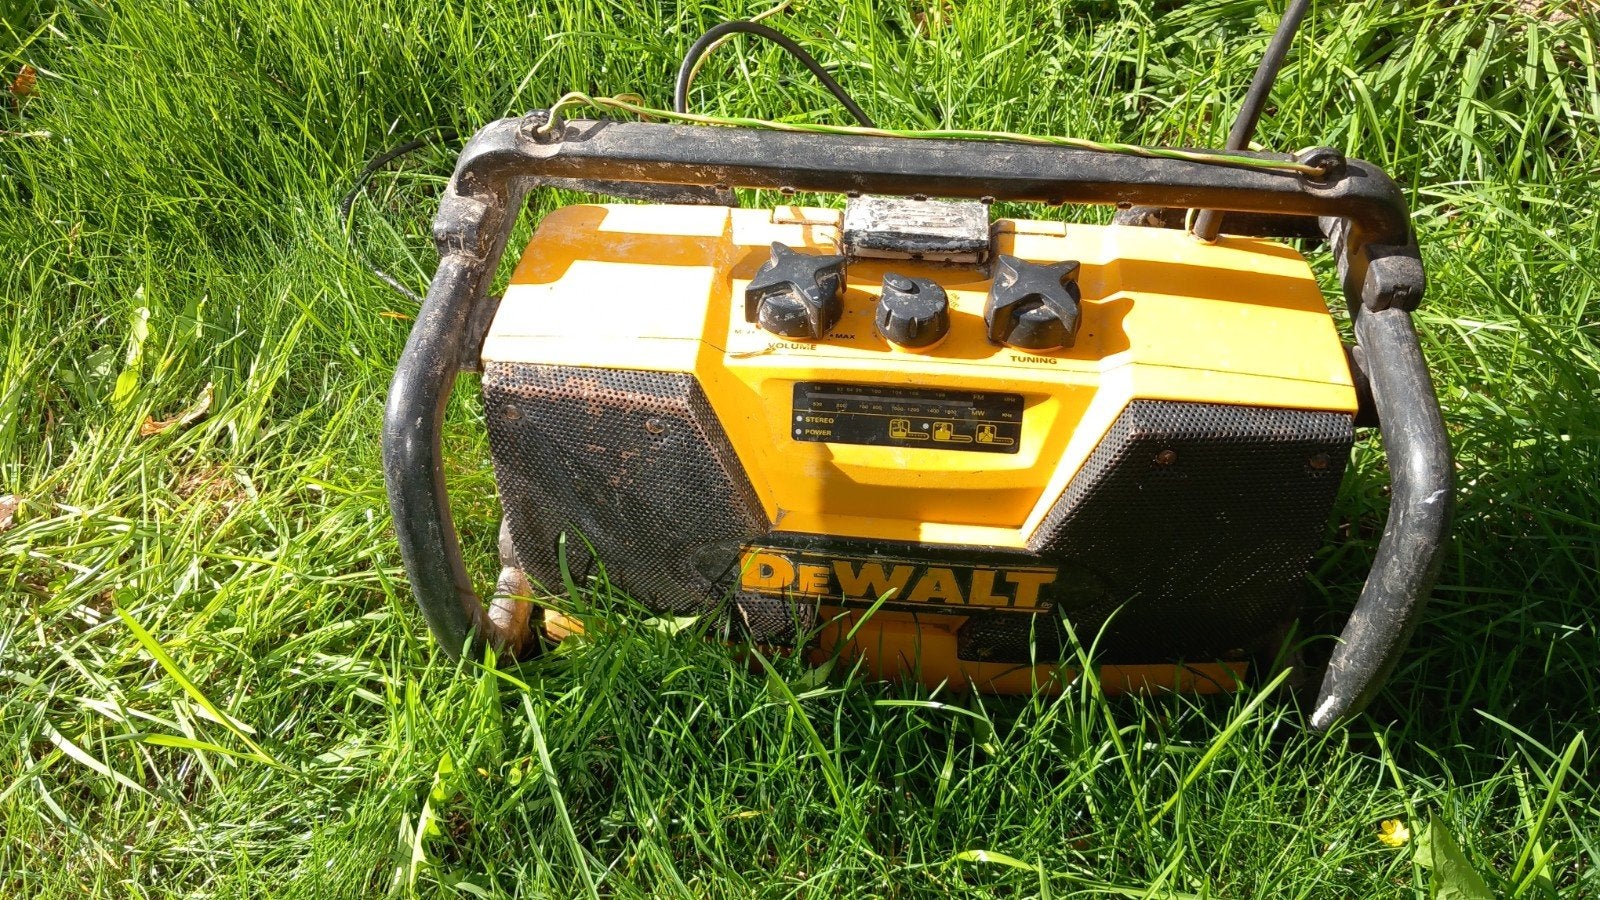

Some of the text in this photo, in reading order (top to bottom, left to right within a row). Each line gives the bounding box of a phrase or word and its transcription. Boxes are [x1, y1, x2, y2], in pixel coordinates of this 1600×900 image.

[767, 342, 817, 351] VOLUME
[1010, 355, 1058, 365] TUNING
[805, 416, 835, 424] STEREO
